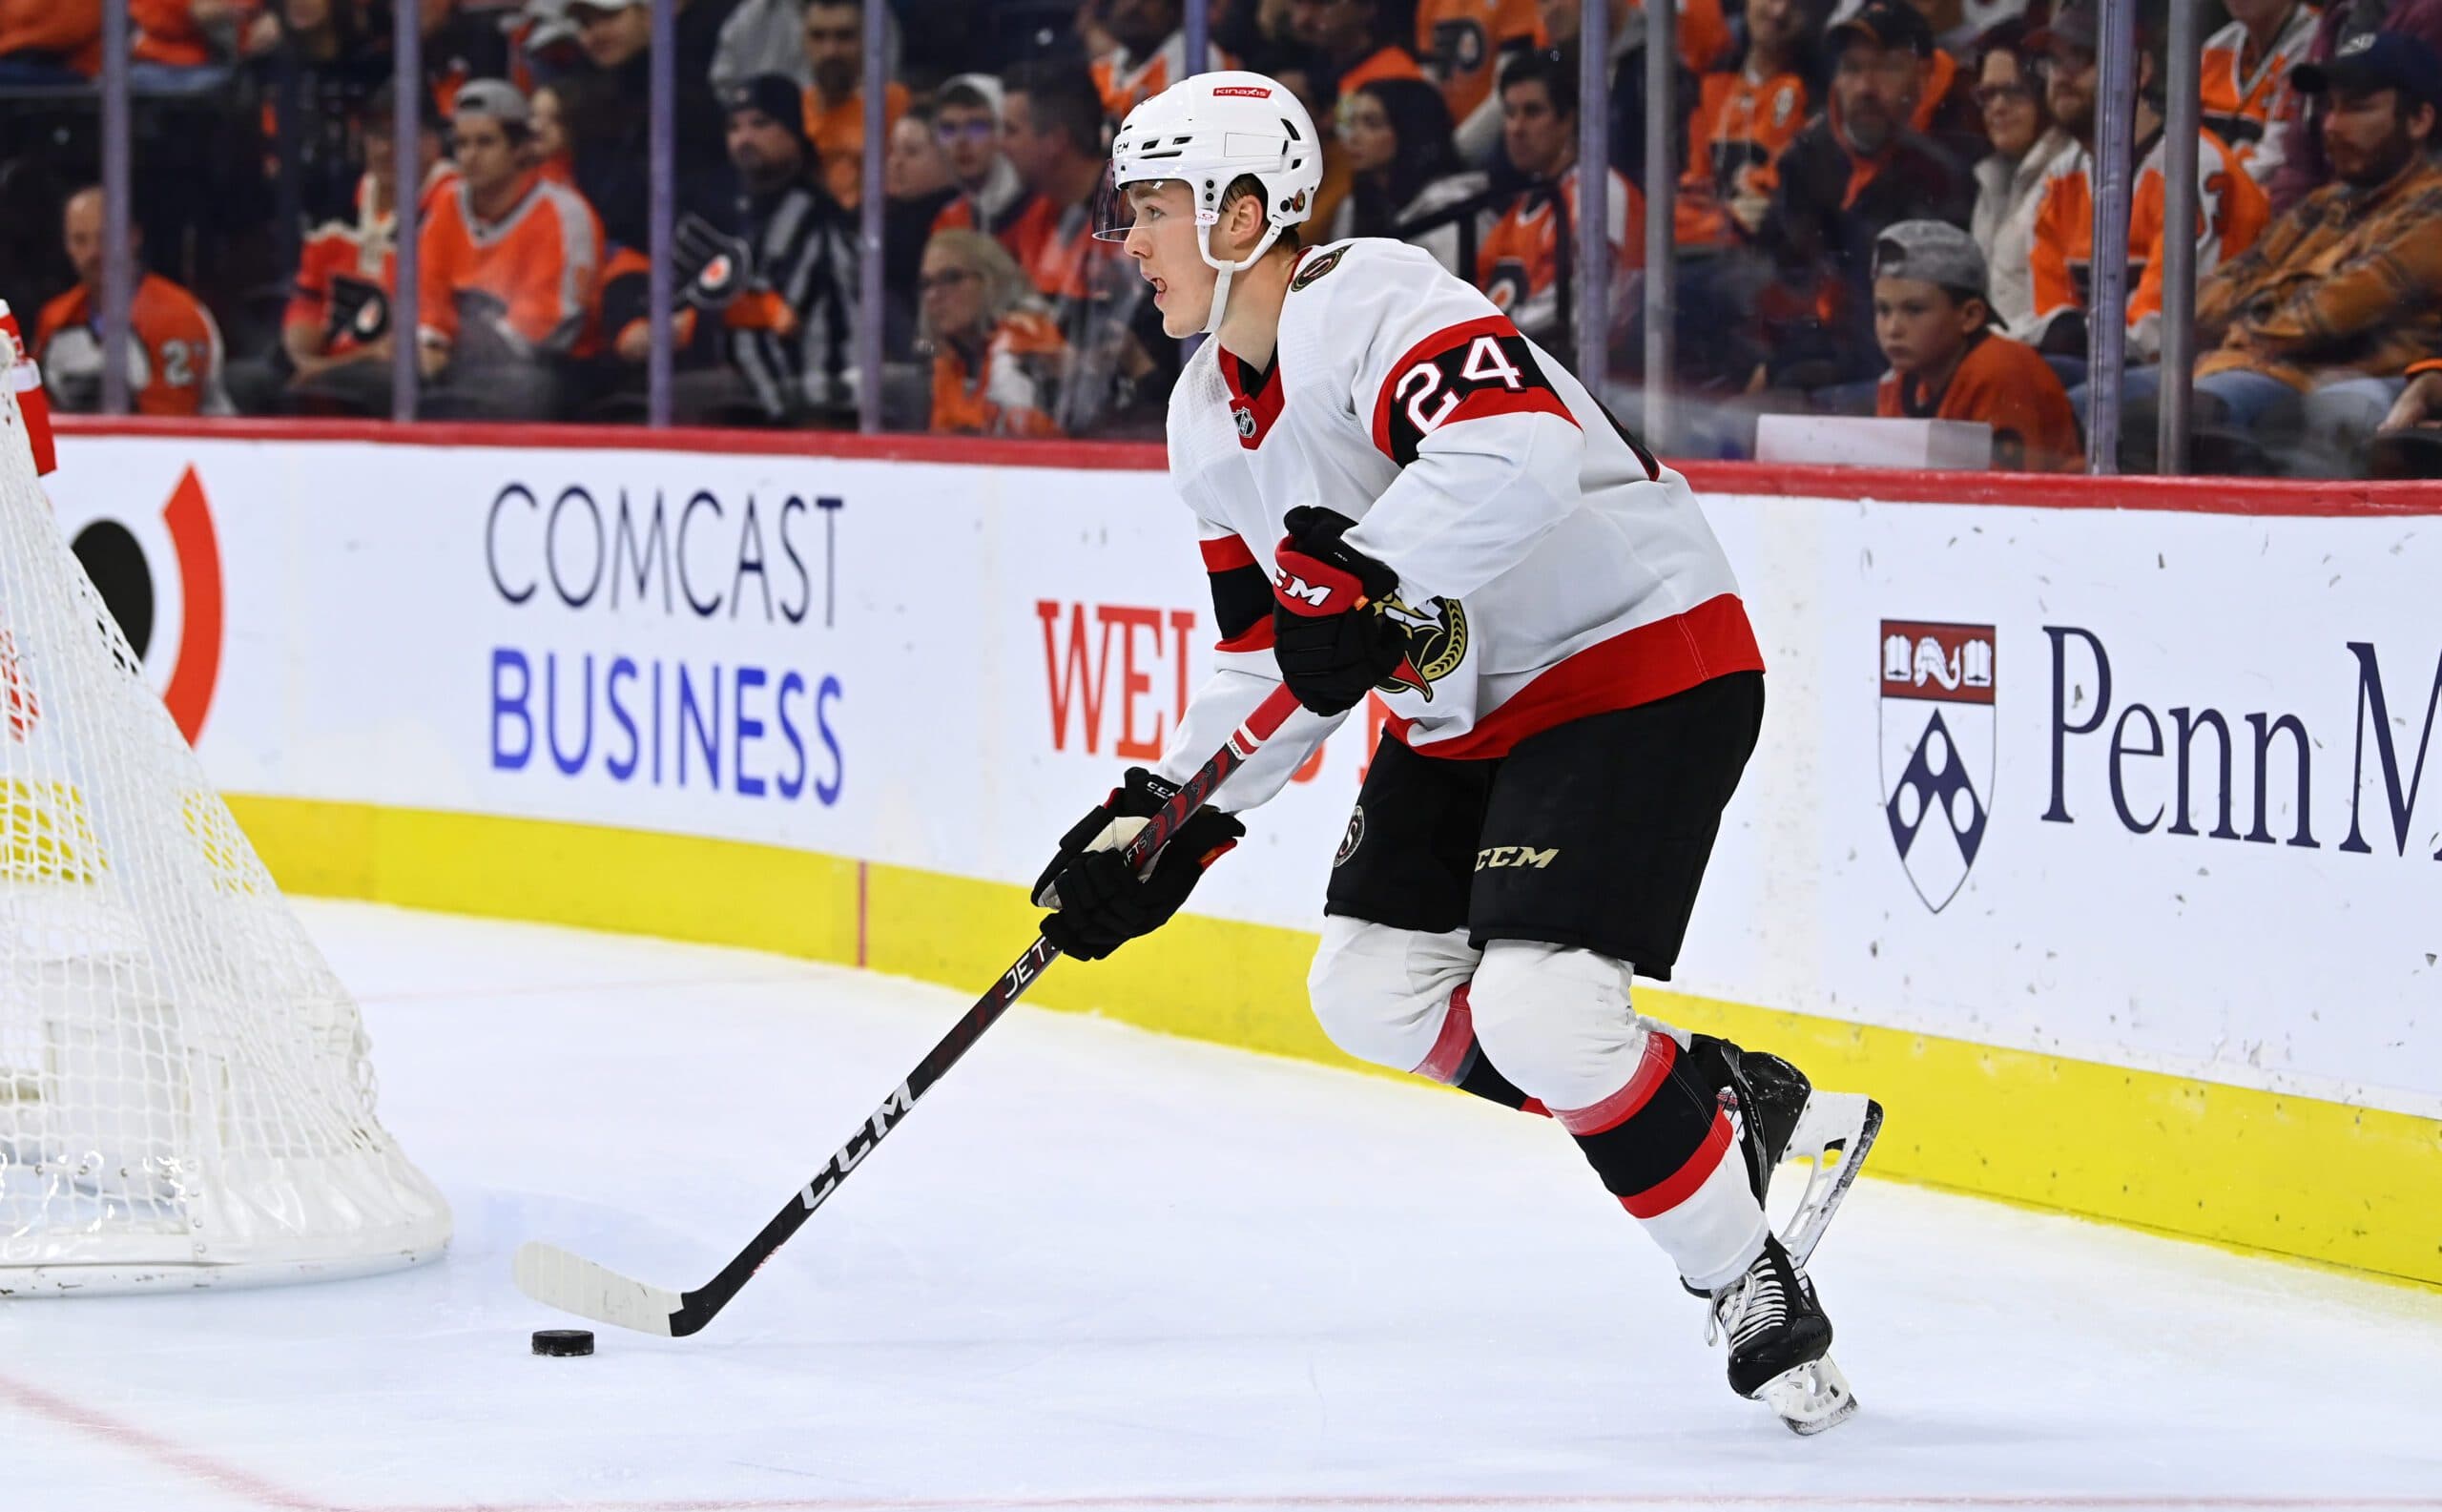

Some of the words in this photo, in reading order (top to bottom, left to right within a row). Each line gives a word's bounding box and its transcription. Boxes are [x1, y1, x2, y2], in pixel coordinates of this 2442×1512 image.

[1395, 334, 1525, 435] 24
[486, 482, 844, 627] COMCAST
[491, 646, 844, 806] BUSINESS
[2040, 625, 2321, 849] Penn
[1474, 846, 1560, 872] CCM
[800, 1078, 915, 1210] CCM
